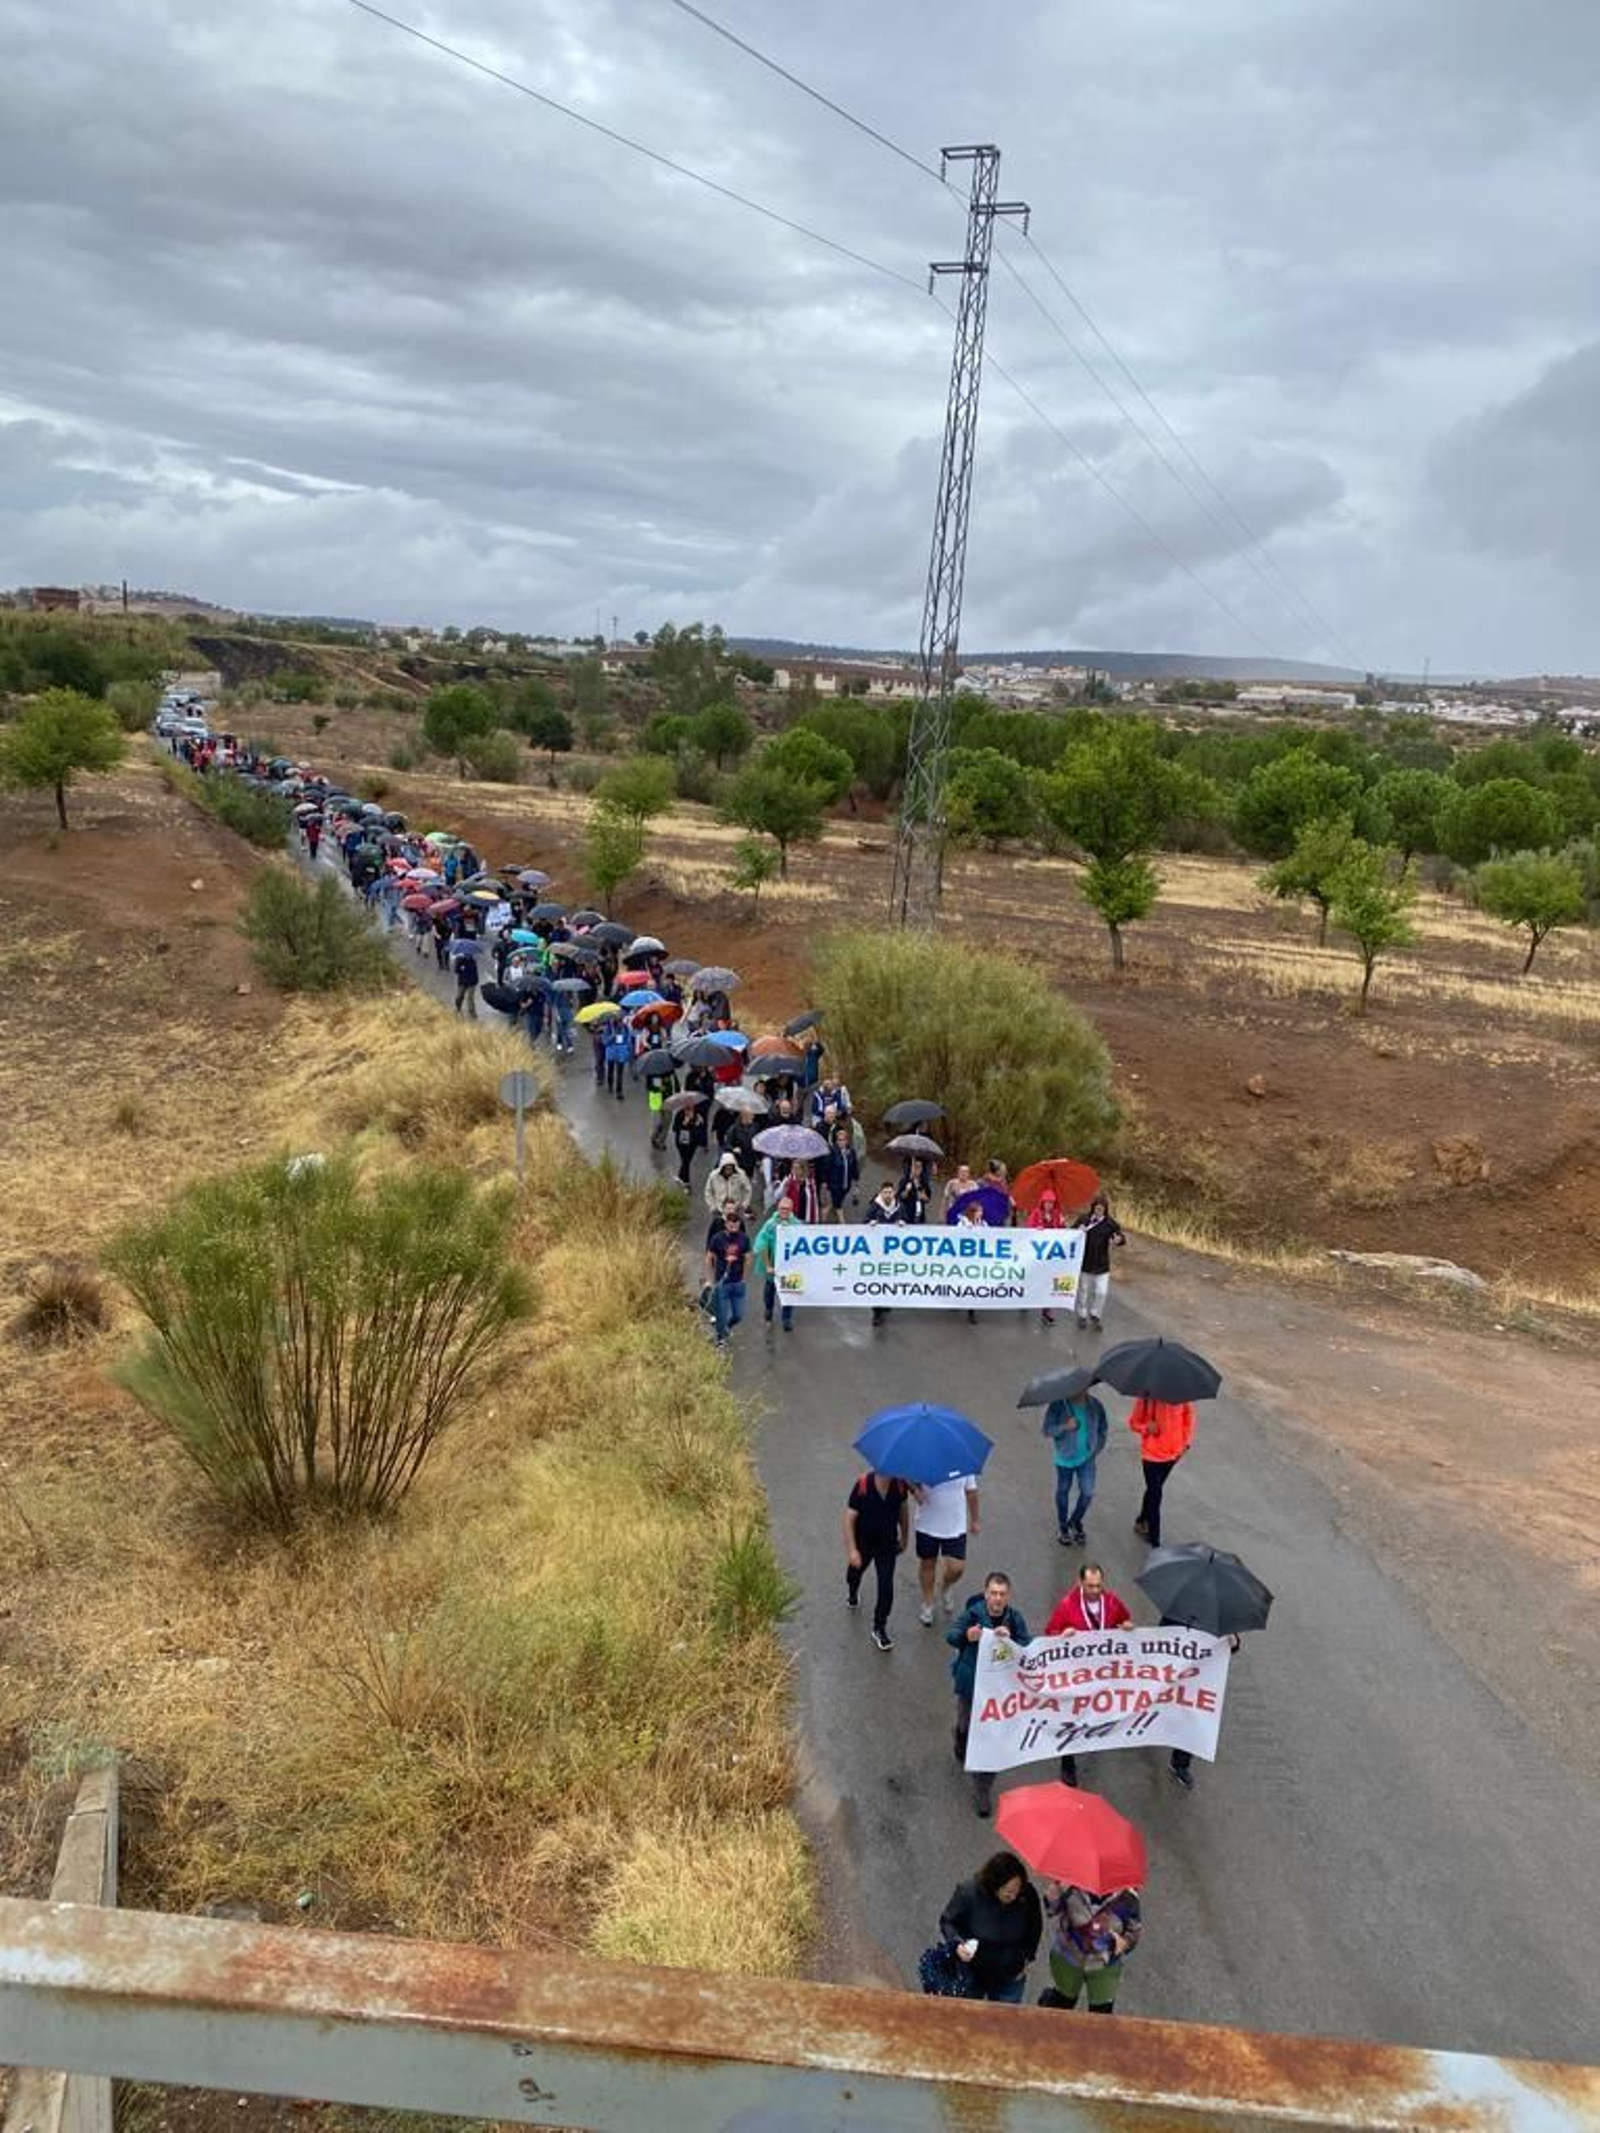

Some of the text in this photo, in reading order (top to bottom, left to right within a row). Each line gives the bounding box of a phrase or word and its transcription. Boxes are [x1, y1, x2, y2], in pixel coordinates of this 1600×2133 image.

[783, 1236, 1077, 1262] ¡AGUA POTABLE, YA!
[859, 1261, 1026, 1280] DEPURACIÓN
[853, 1281, 1025, 1299] CONTAMINACIÓN
[1141, 1636, 1213, 1660] unida
[980, 1686, 1217, 1722] AGUA POTABLE
